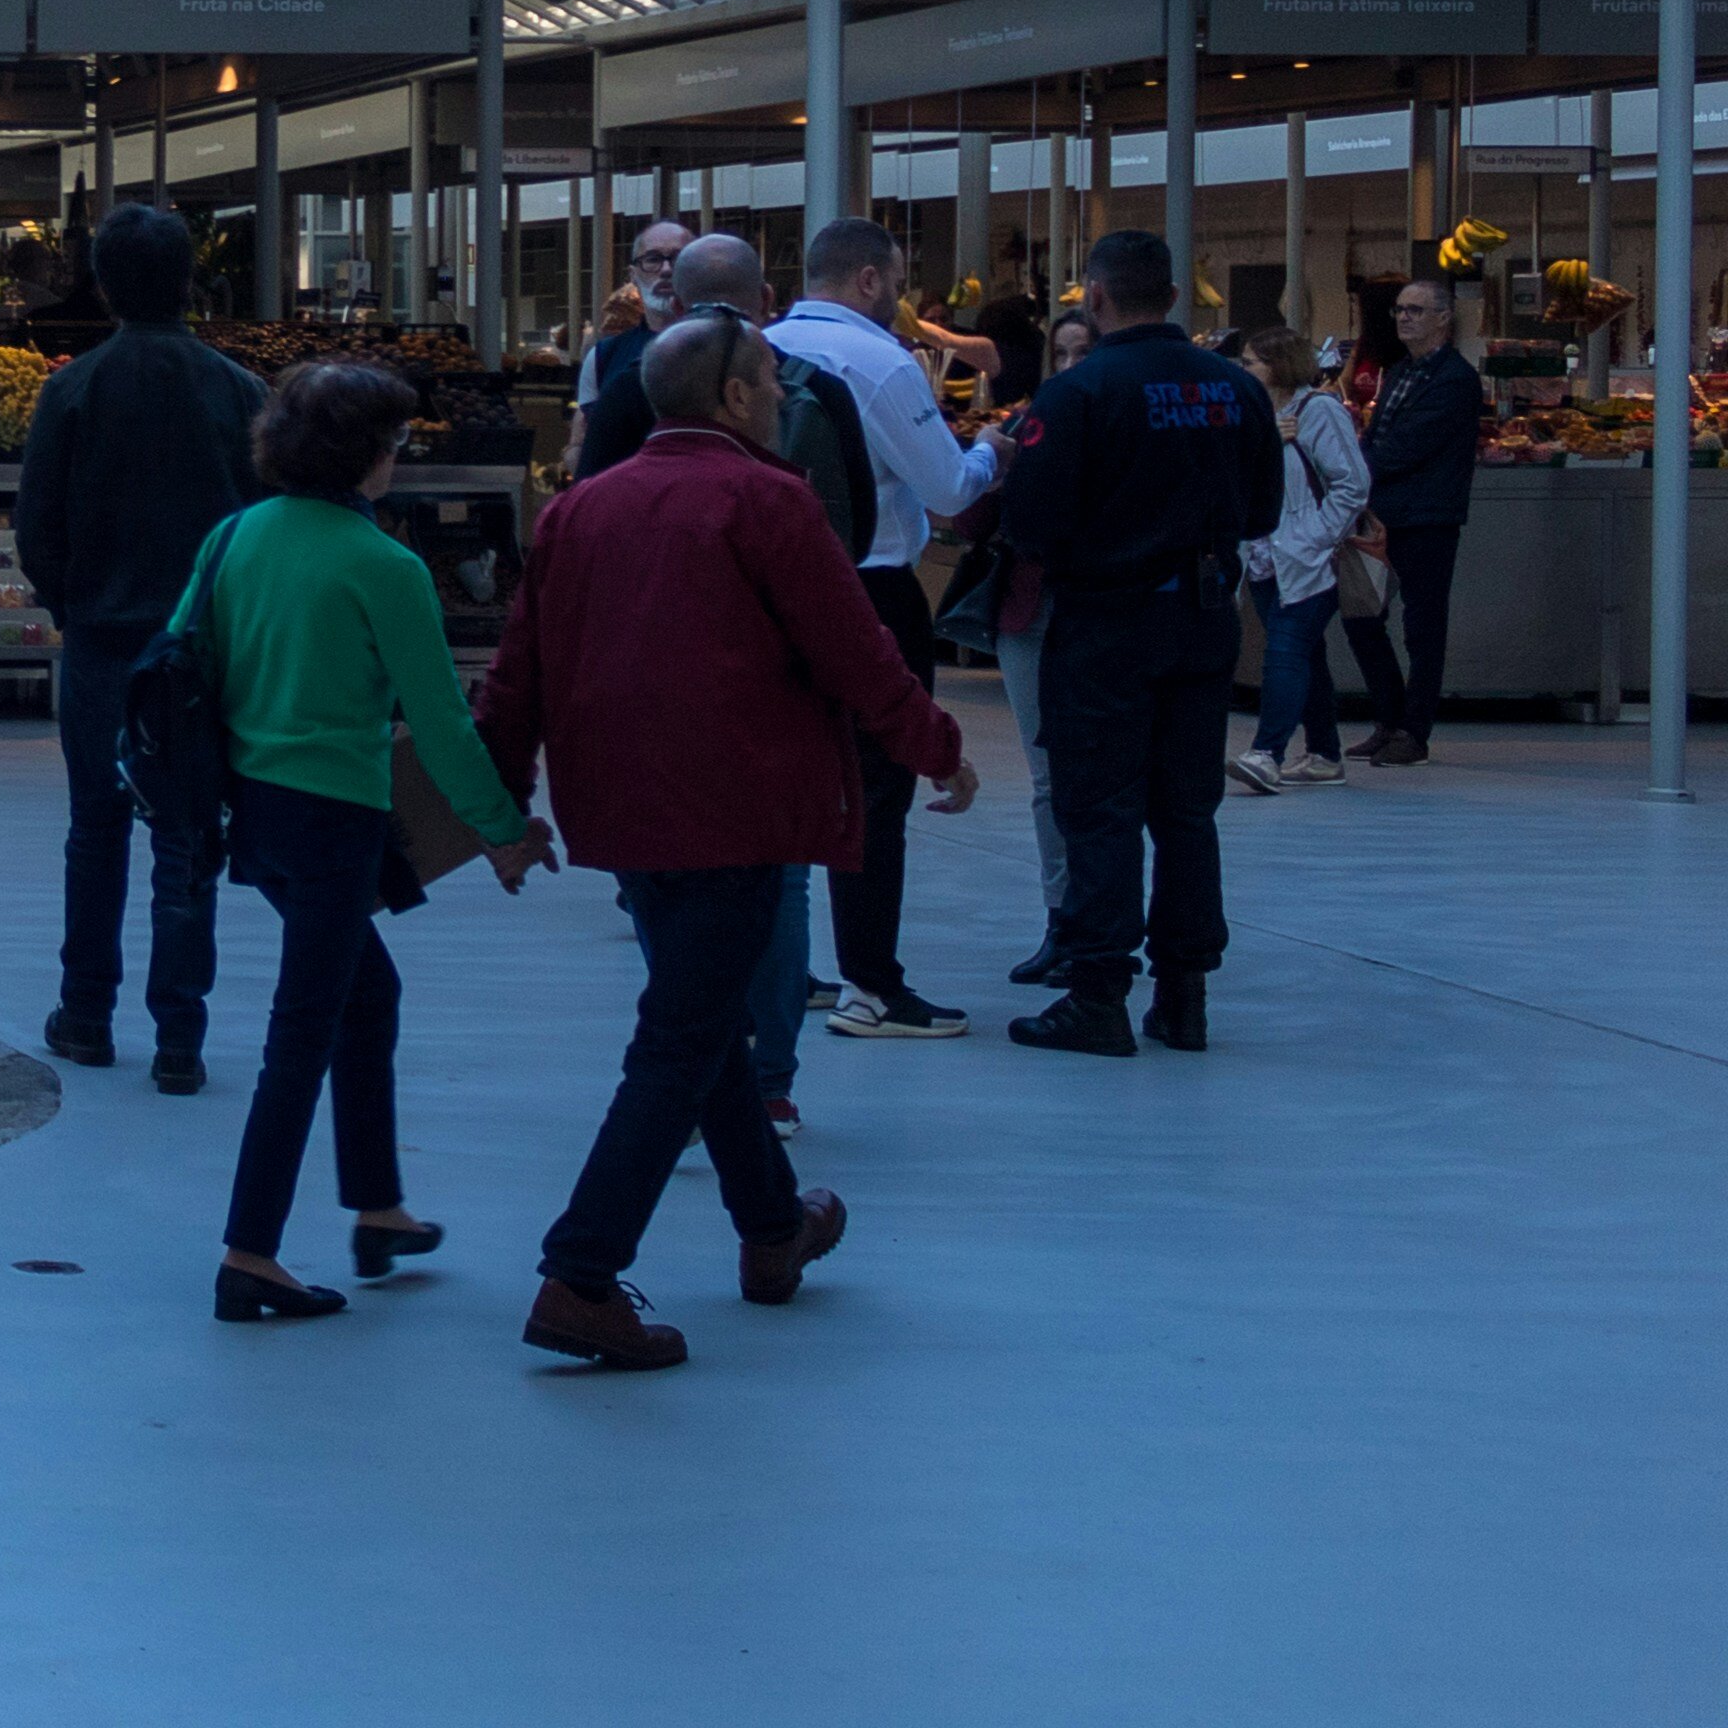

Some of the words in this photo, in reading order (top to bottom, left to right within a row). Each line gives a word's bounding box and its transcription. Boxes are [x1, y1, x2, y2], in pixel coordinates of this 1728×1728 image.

[231, 0, 254, 13] na
[1475, 154, 1496, 165] Rua
[1143, 381, 1236, 405] STRONG
[1148, 403, 1242, 430] CHARON
